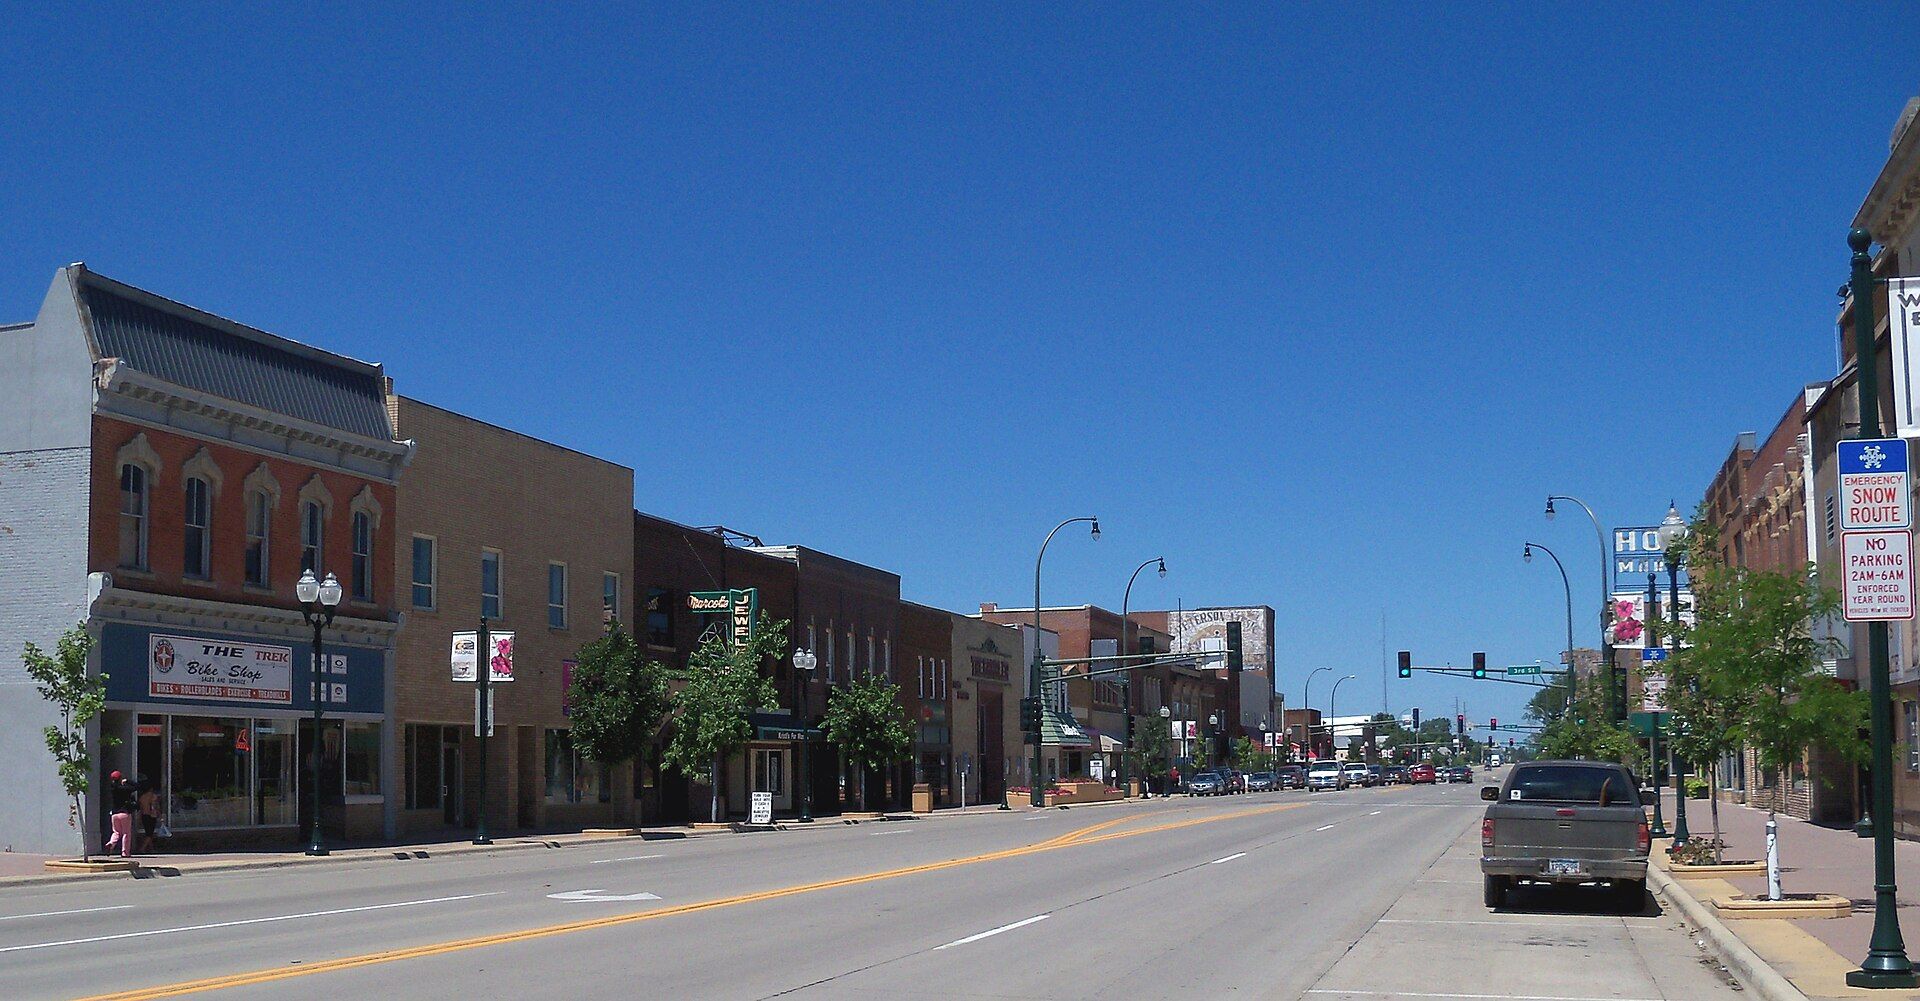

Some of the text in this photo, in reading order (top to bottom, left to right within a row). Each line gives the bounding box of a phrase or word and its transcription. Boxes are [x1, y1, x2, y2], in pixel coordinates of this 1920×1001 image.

[1844, 475, 1903, 486] EMERGENCY
[1852, 487, 1896, 504] SNOW
[1850, 506, 1900, 523] ROUTE
[1866, 538, 1886, 551] NO
[1851, 554, 1903, 567] PARKING
[1852, 570, 1904, 581] 2AM-6AM
[1857, 584, 1899, 593] ENFORCED
[1853, 594, 1905, 604] YEAR ROUND
[202, 644, 289, 663] THE TREK
[187, 661, 263, 683] Bike Shop
[156, 684, 174, 694] BIKES
[180, 685, 222, 696] ROLLERBLADES
